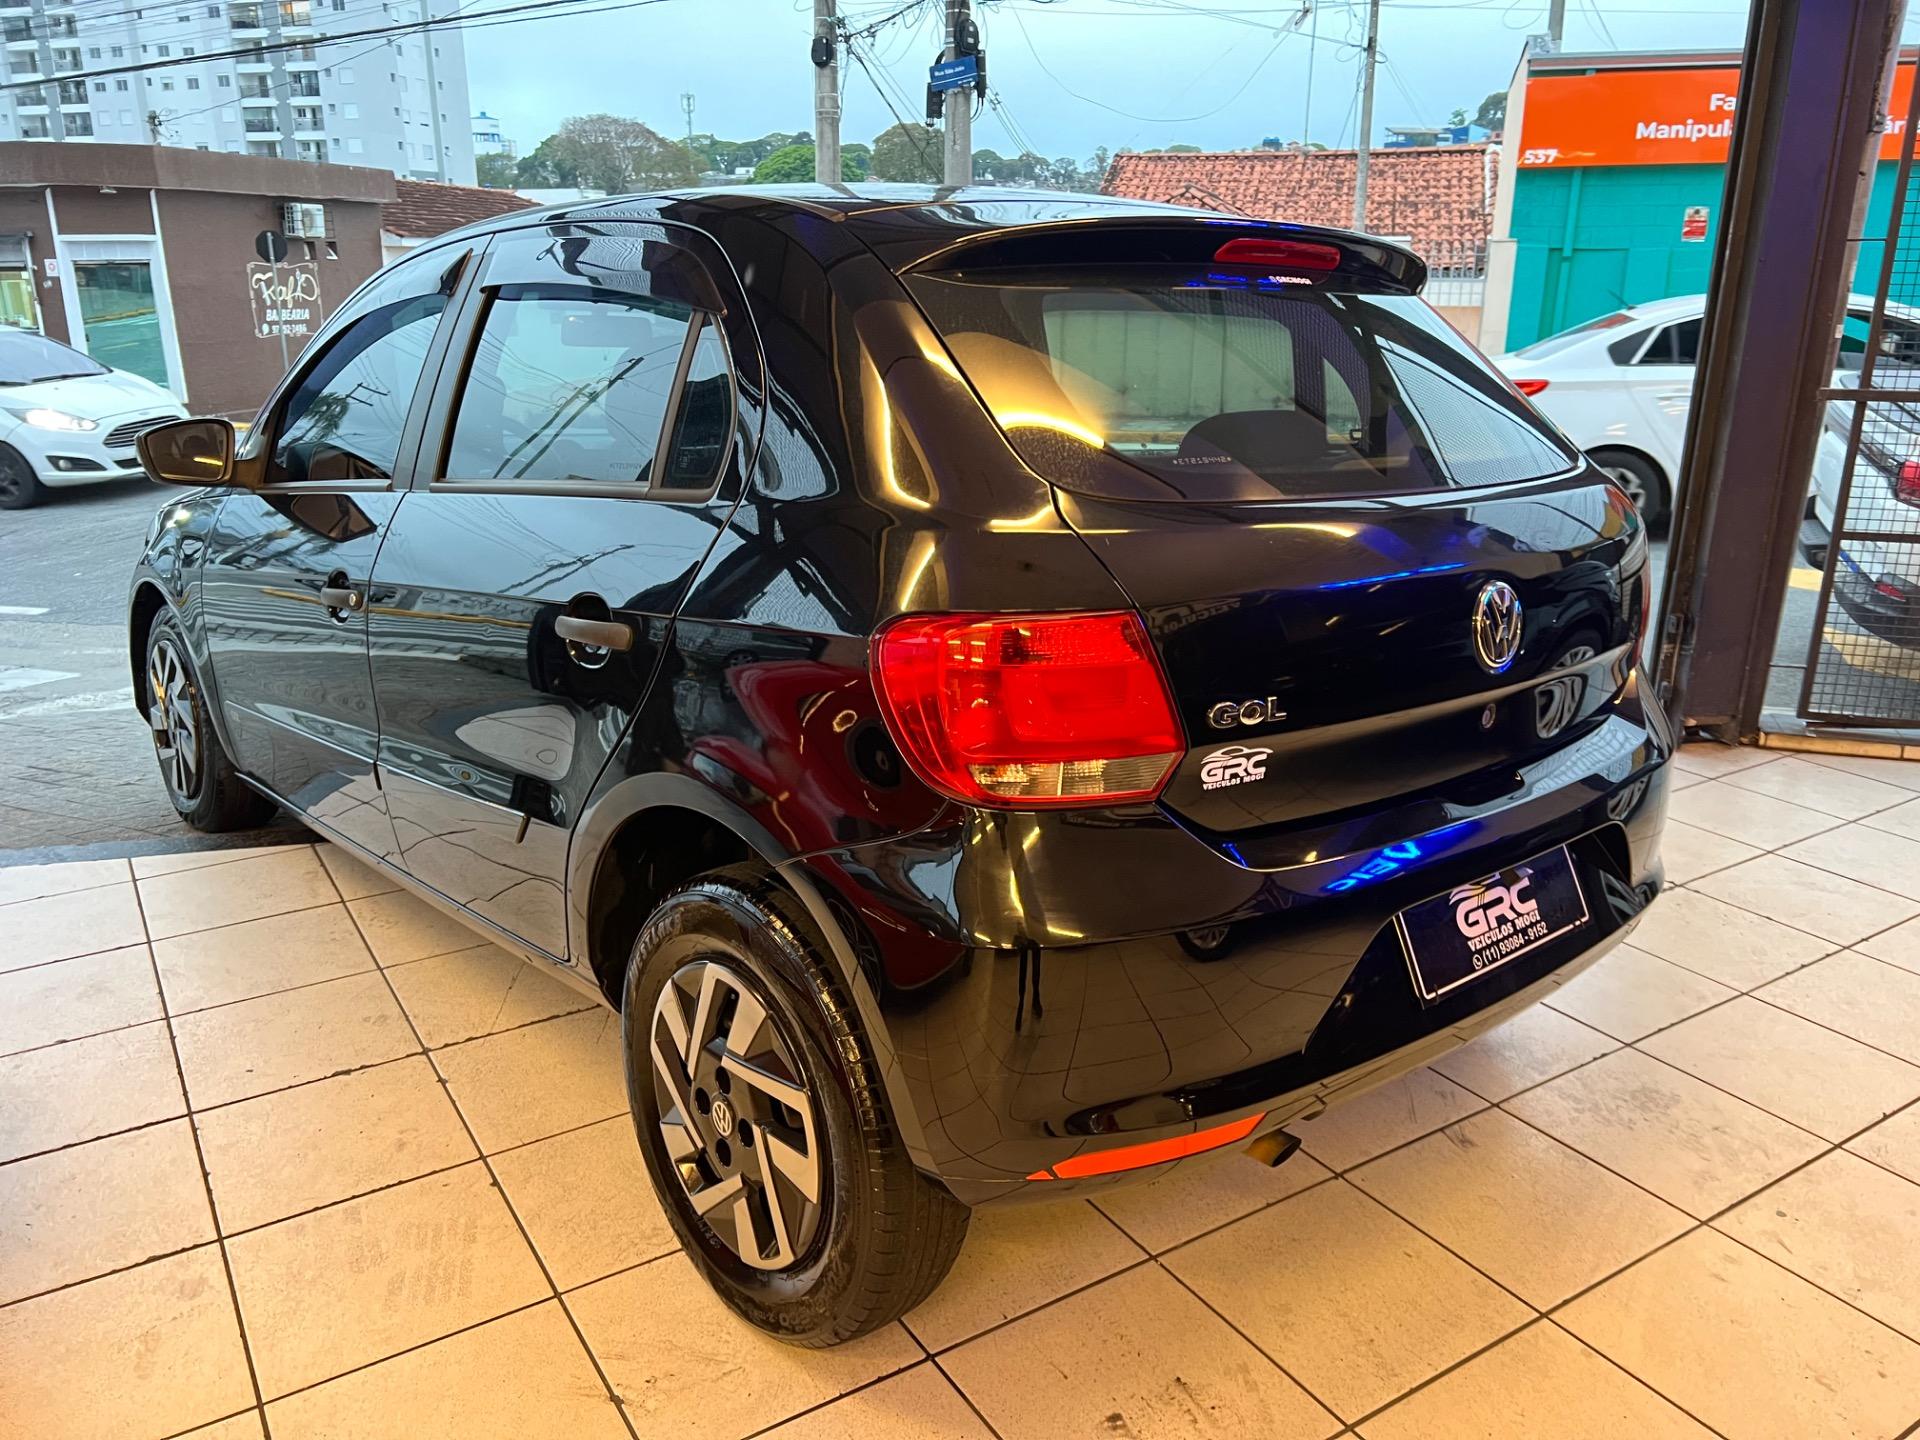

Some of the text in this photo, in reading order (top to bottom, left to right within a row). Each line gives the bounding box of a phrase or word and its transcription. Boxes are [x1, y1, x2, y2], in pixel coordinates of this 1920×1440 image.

[1635, 118, 1734, 143] Manipul
[1523, 149, 1558, 164] 537
[265, 308, 310, 322] BABEARIA
[1208, 696, 1288, 729] GOL
[1200, 753, 1268, 784] GRC
[1202, 773, 1265, 791] VEICULOS MOGI
[1455, 876, 1539, 939] GRC
[1467, 909, 1541, 952] VEICULOS MOGI
[1482, 945, 1501, 965] (11)
[1528, 921, 1549, 941] 9152
